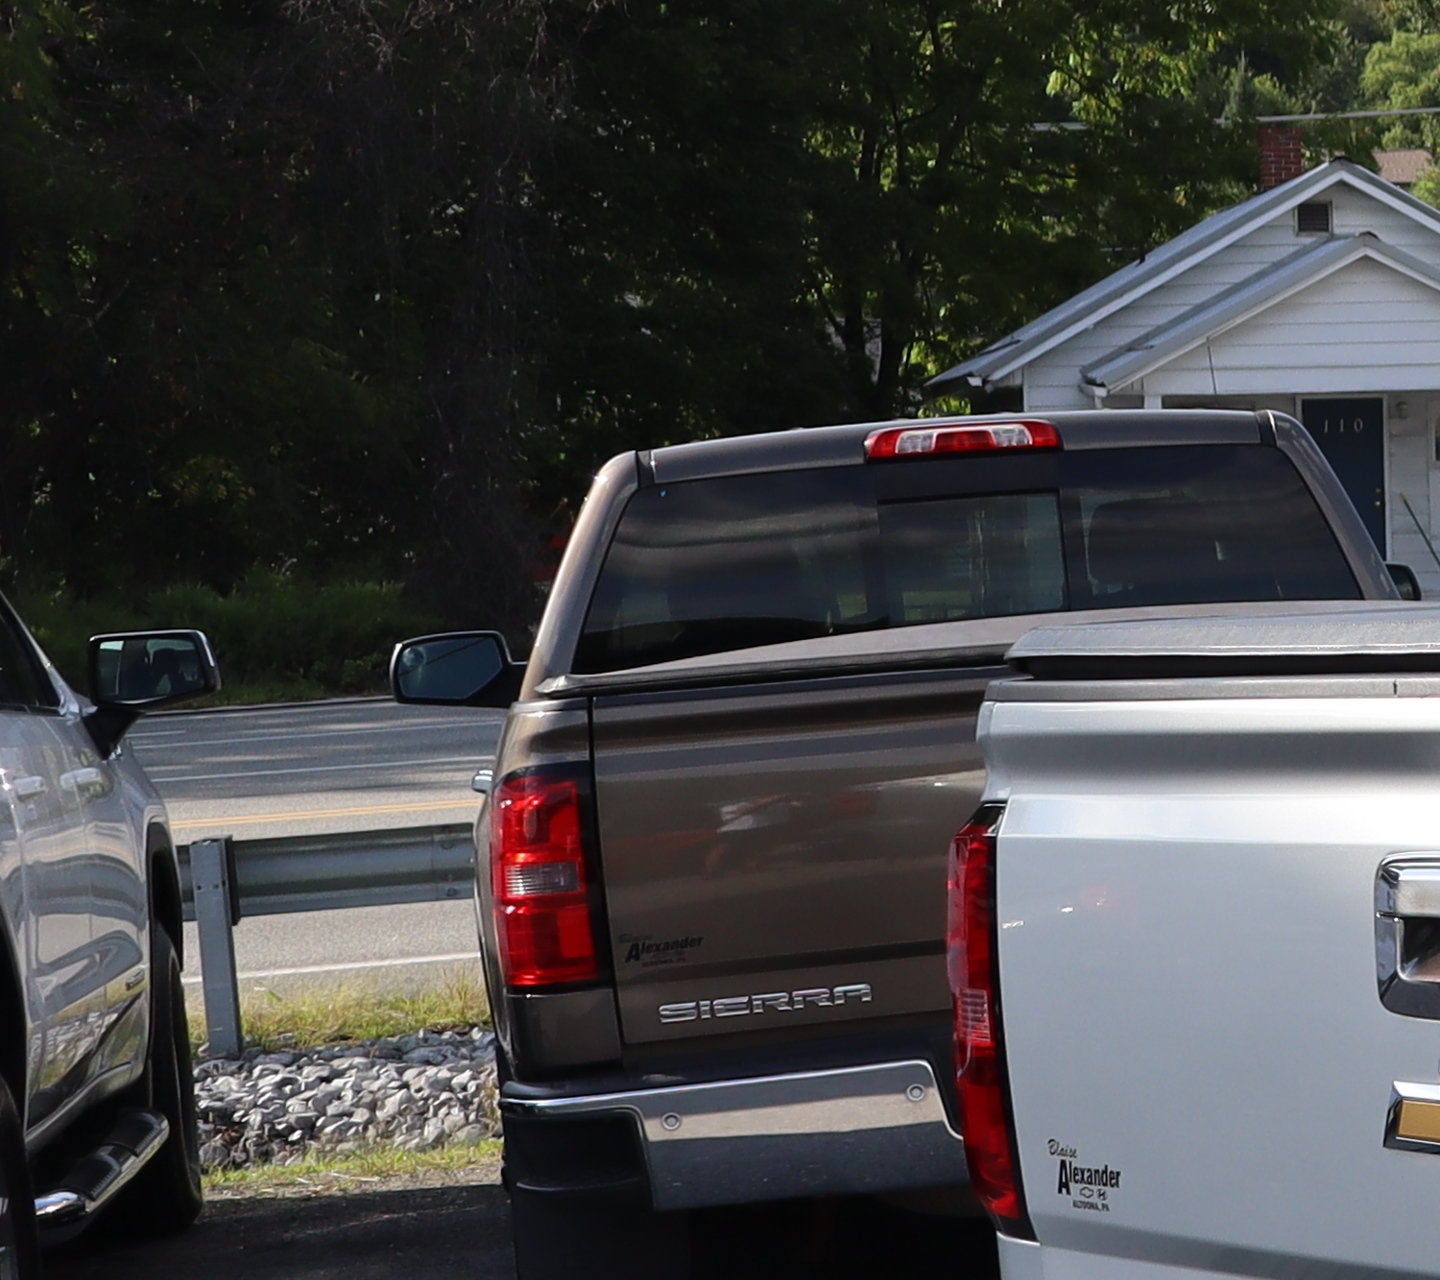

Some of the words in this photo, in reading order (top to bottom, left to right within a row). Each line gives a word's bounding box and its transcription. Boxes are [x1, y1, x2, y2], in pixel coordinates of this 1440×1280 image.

[1324, 418, 1364, 433] 110
[624, 936, 704, 963] Alexander
[658, 983, 873, 1024] SIERRA
[1057, 1159, 1121, 1196] Alexander
